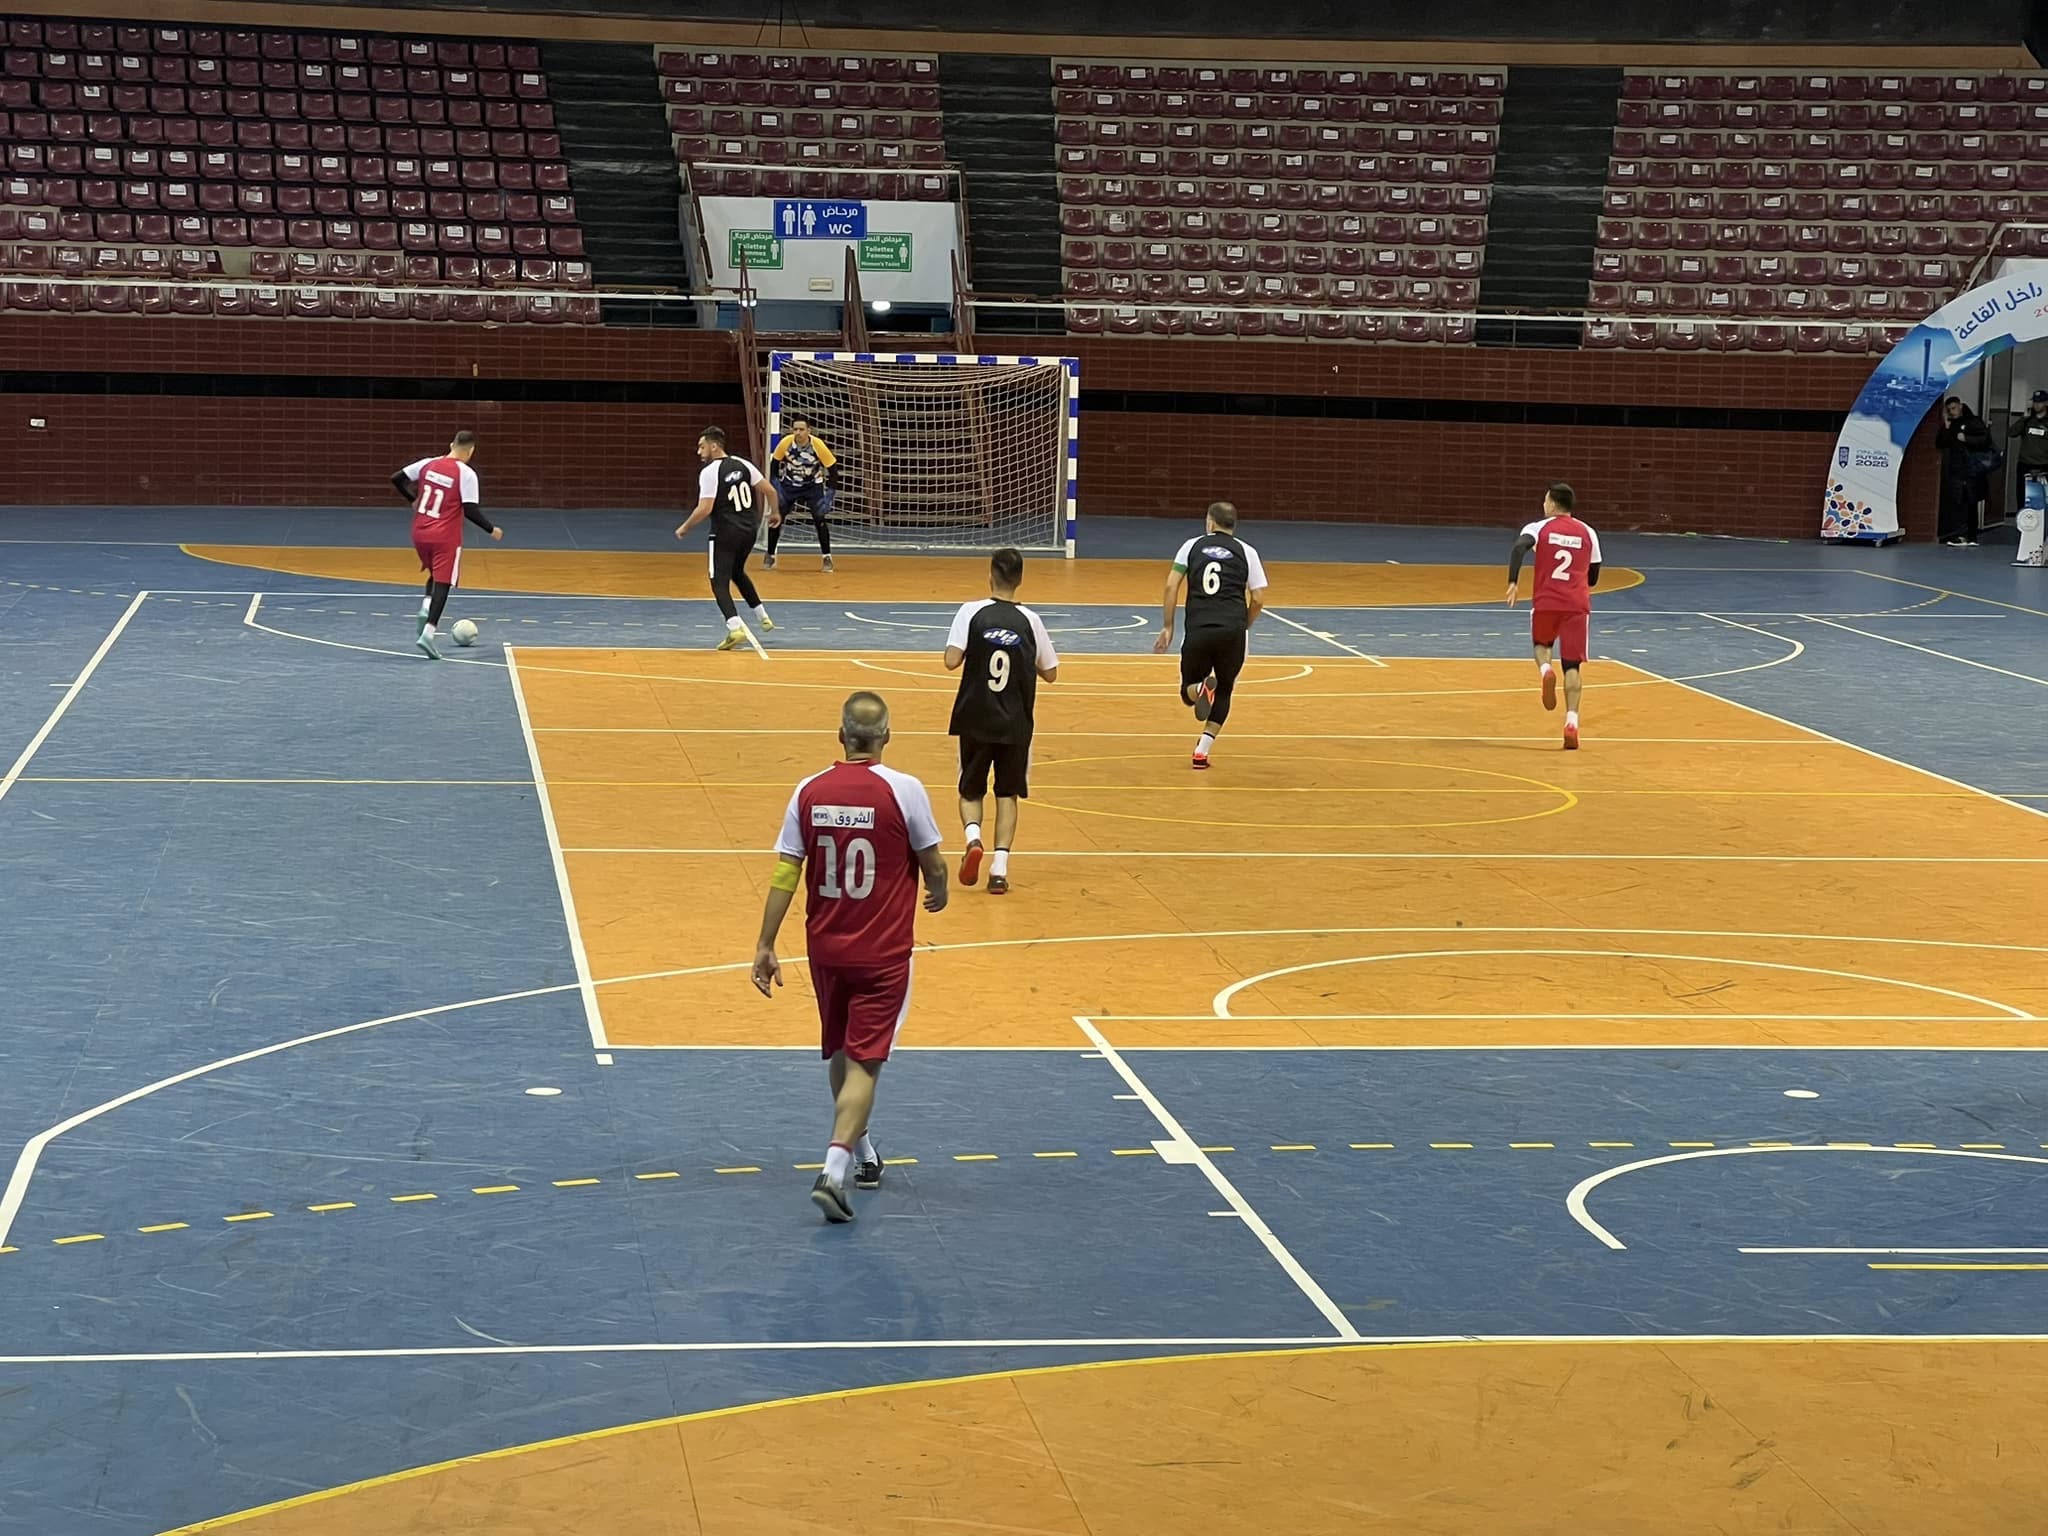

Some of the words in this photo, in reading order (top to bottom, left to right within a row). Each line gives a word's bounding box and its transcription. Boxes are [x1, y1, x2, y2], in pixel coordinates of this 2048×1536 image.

[822, 205, 858, 218] مرحاض
[828, 224, 852, 234] WC
[2005, 282, 2043, 311] داخل
[1955, 298, 2001, 340] القاعة
[1856, 460, 1889, 468] 2025
[418, 484, 444, 519] 11
[728, 481, 752, 512] 10
[1202, 561, 1222, 595] 6
[1551, 549, 1573, 581] 2
[987, 649, 1011, 693] 9
[813, 812, 829, 820] NEWS
[835, 810, 874, 827] الشروق
[817, 835, 876, 900] 10
